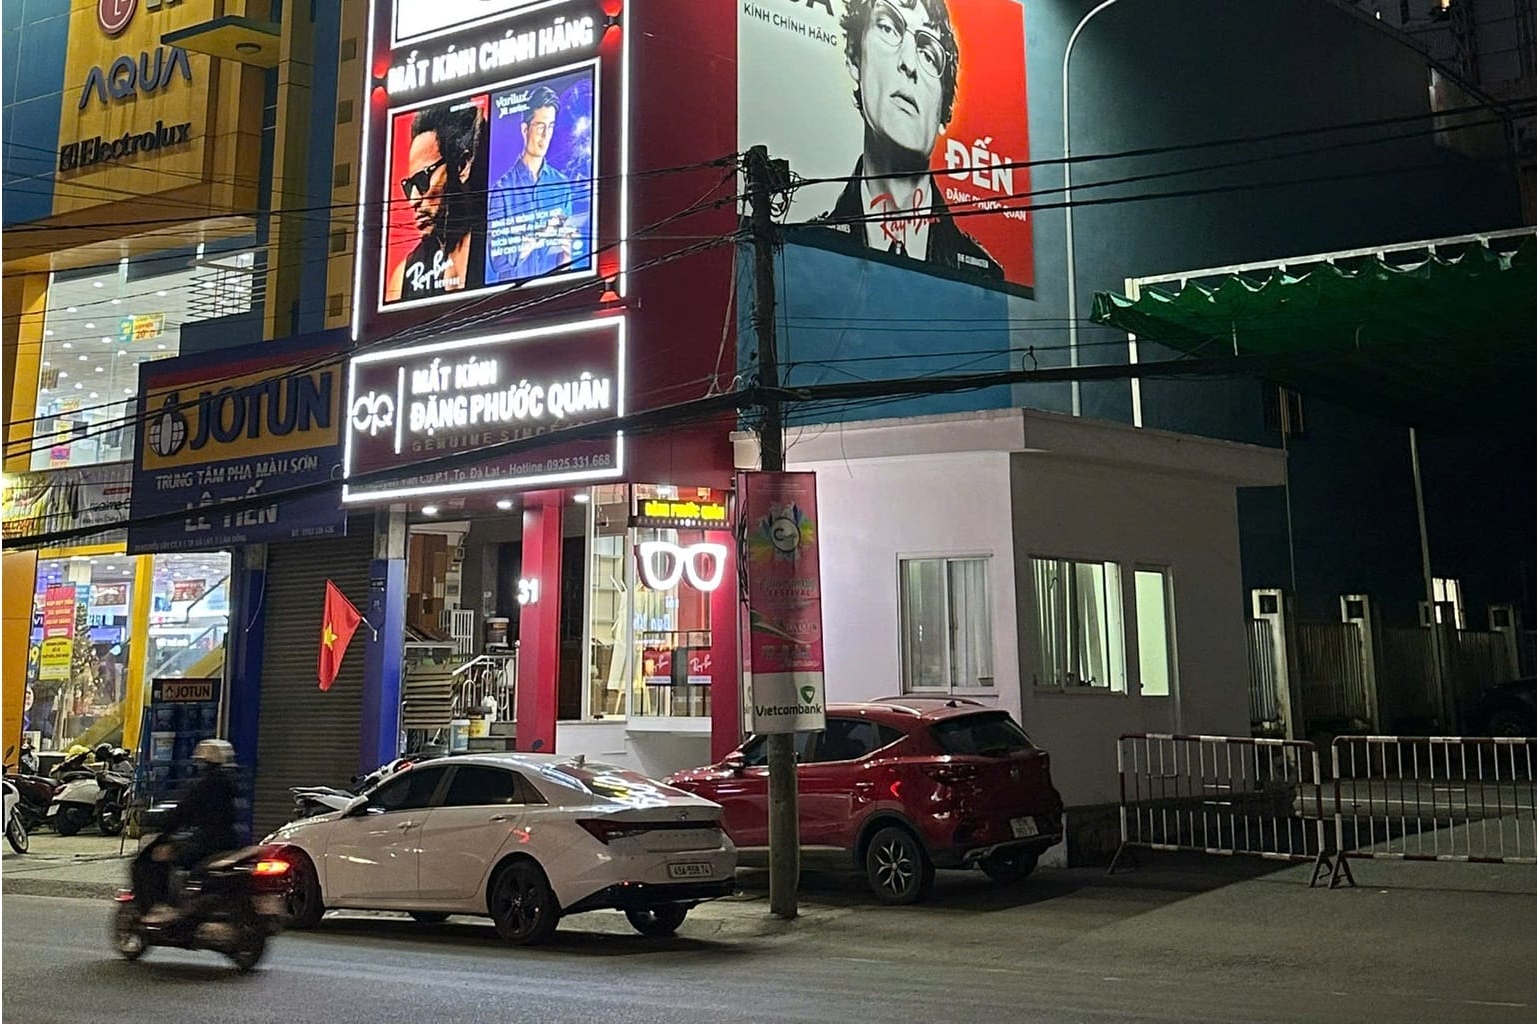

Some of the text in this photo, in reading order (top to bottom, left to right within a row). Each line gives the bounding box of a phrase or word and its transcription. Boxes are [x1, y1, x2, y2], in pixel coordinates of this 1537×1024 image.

[743, 1, 838, 47] KÍNH CHÍNH HÃNG
[432, 44, 477, 84] KÍNH
[479, 29, 536, 72] CHÍNH
[539, 15, 594, 57] HÃNG
[79, 47, 192, 109] AQUA
[81, 119, 192, 168] Electrolux
[944, 136, 1014, 197] ĐẾN
[411, 358, 451, 395] MẮT
[190, 372, 332, 451] JOTUN
[410, 372, 610, 436] ĐẶNG PHƯỚC QUÂN
[155, 454, 318, 490] TRUNG TÂM PHA MÀU SƠN
[517, 578, 538, 606] 31
[174, 683, 211, 698] JOTUN
[755, 702, 822, 718] Vietcombank
